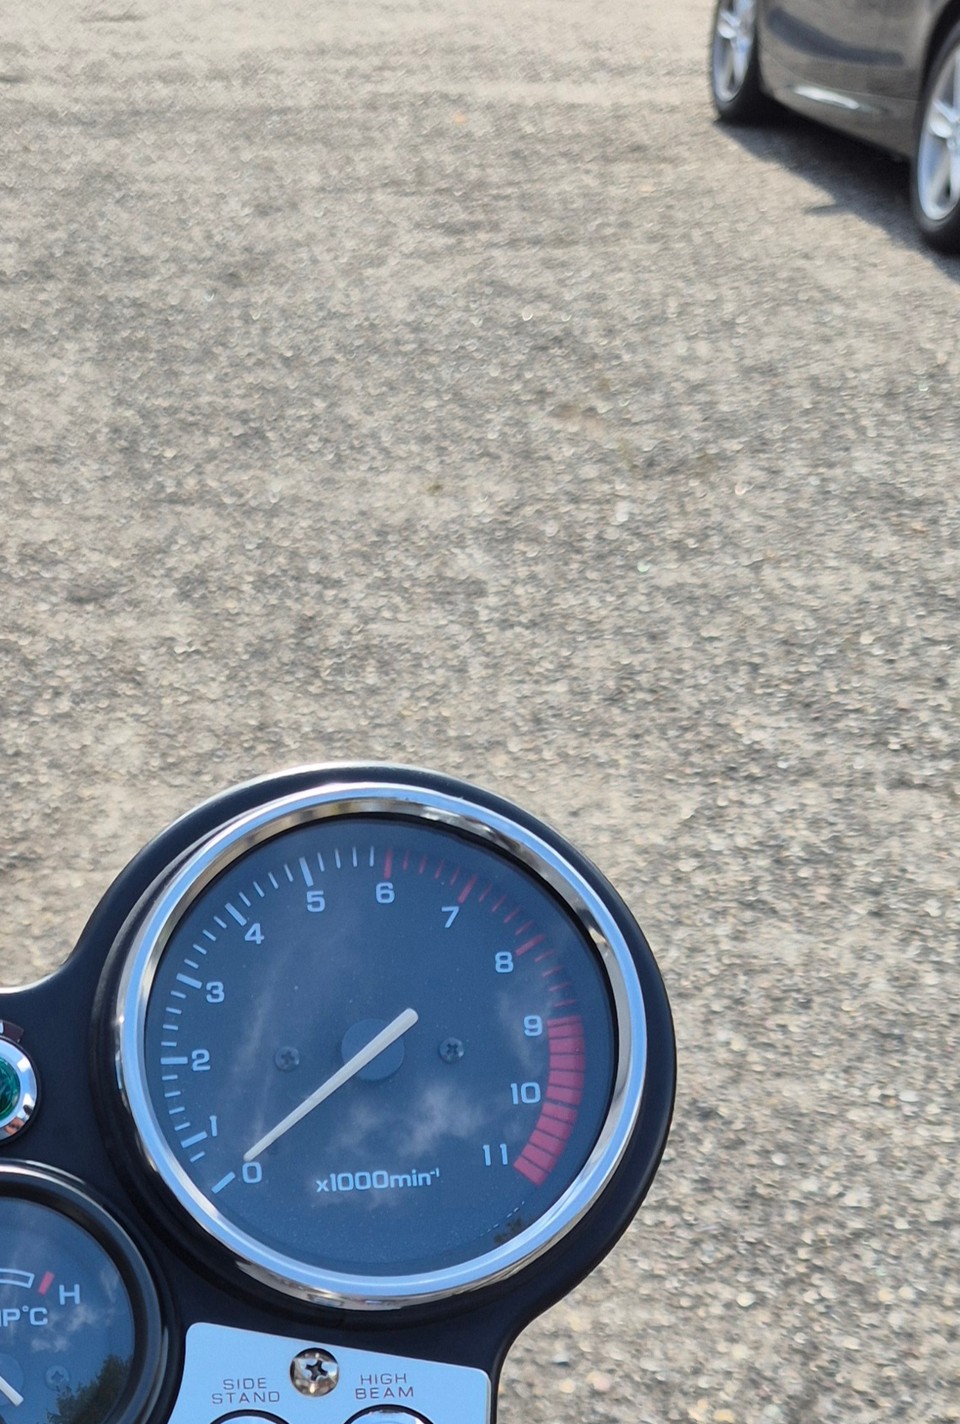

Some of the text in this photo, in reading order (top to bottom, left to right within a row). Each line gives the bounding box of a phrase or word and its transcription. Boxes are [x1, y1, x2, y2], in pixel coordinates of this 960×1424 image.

[307, 891, 325, 911] 5
[375, 883, 395, 904] 6
[441, 906, 459, 928] 7
[245, 924, 264, 944] 4
[494, 952, 513, 973] 8
[206, 982, 224, 1002] 3
[524, 1016, 542, 1036] 9
[191, 1049, 210, 1070] 2
[511, 1082, 540, 1104] 10
[210, 1116, 218, 1136] 1
[483, 1143, 508, 1166] 11
[243, 1162, 262, 1183] 0
[59, 1285, 80, 1305] H
[223, 1377, 267, 1390] SIDE
[360, 1373, 407, 1386] HIGH
[211, 1391, 280, 1404] STAND
[355, 1386, 414, 1399] BEAM
